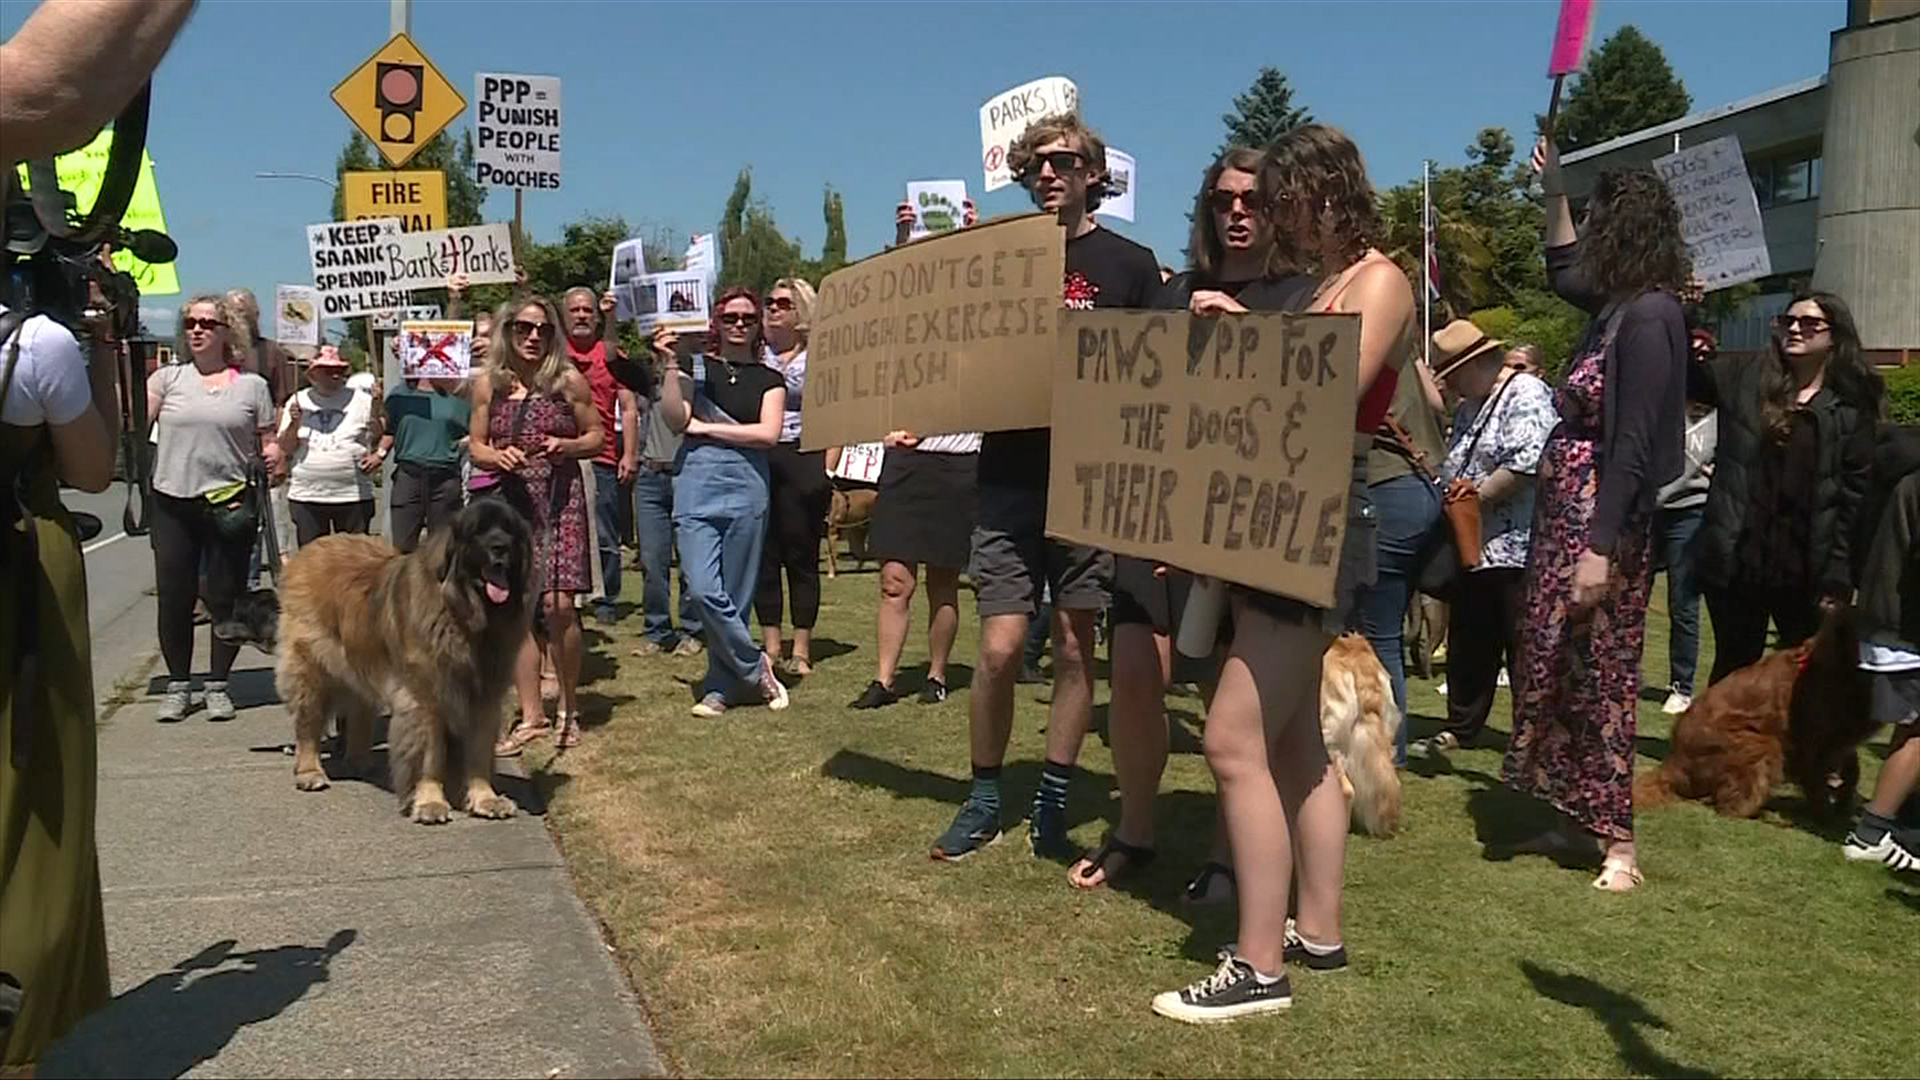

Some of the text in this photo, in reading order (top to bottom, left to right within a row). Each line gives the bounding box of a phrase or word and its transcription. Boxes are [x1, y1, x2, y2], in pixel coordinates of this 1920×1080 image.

[485, 77, 531, 104] PPP
[479, 101, 558, 127] PUNISH
[988, 87, 1047, 129] PARKS
[478, 126, 560, 152] PEOPLE
[504, 153, 534, 163] WITH
[476, 163, 560, 189] POOCHES
[372, 183, 422, 204] FIRE
[328, 223, 381, 247] KEEP
[315, 244, 384, 268] SAANIC
[441, 234, 460, 274] 4
[460, 235, 510, 273] Parks
[818, 275, 871, 321] DOGS
[966, 247, 1047, 288] GET
[324, 289, 411, 314] ON-LEASH
[816, 297, 1049, 362] ENOUGH EXERCISE
[1076, 315, 1168, 389] PAWS
[814, 350, 948, 408] ON LEASH
[1119, 403, 1171, 453] THE
[1185, 392, 1272, 461] DOGS
[1075, 461, 1343, 567] THEIR PEOPLE
